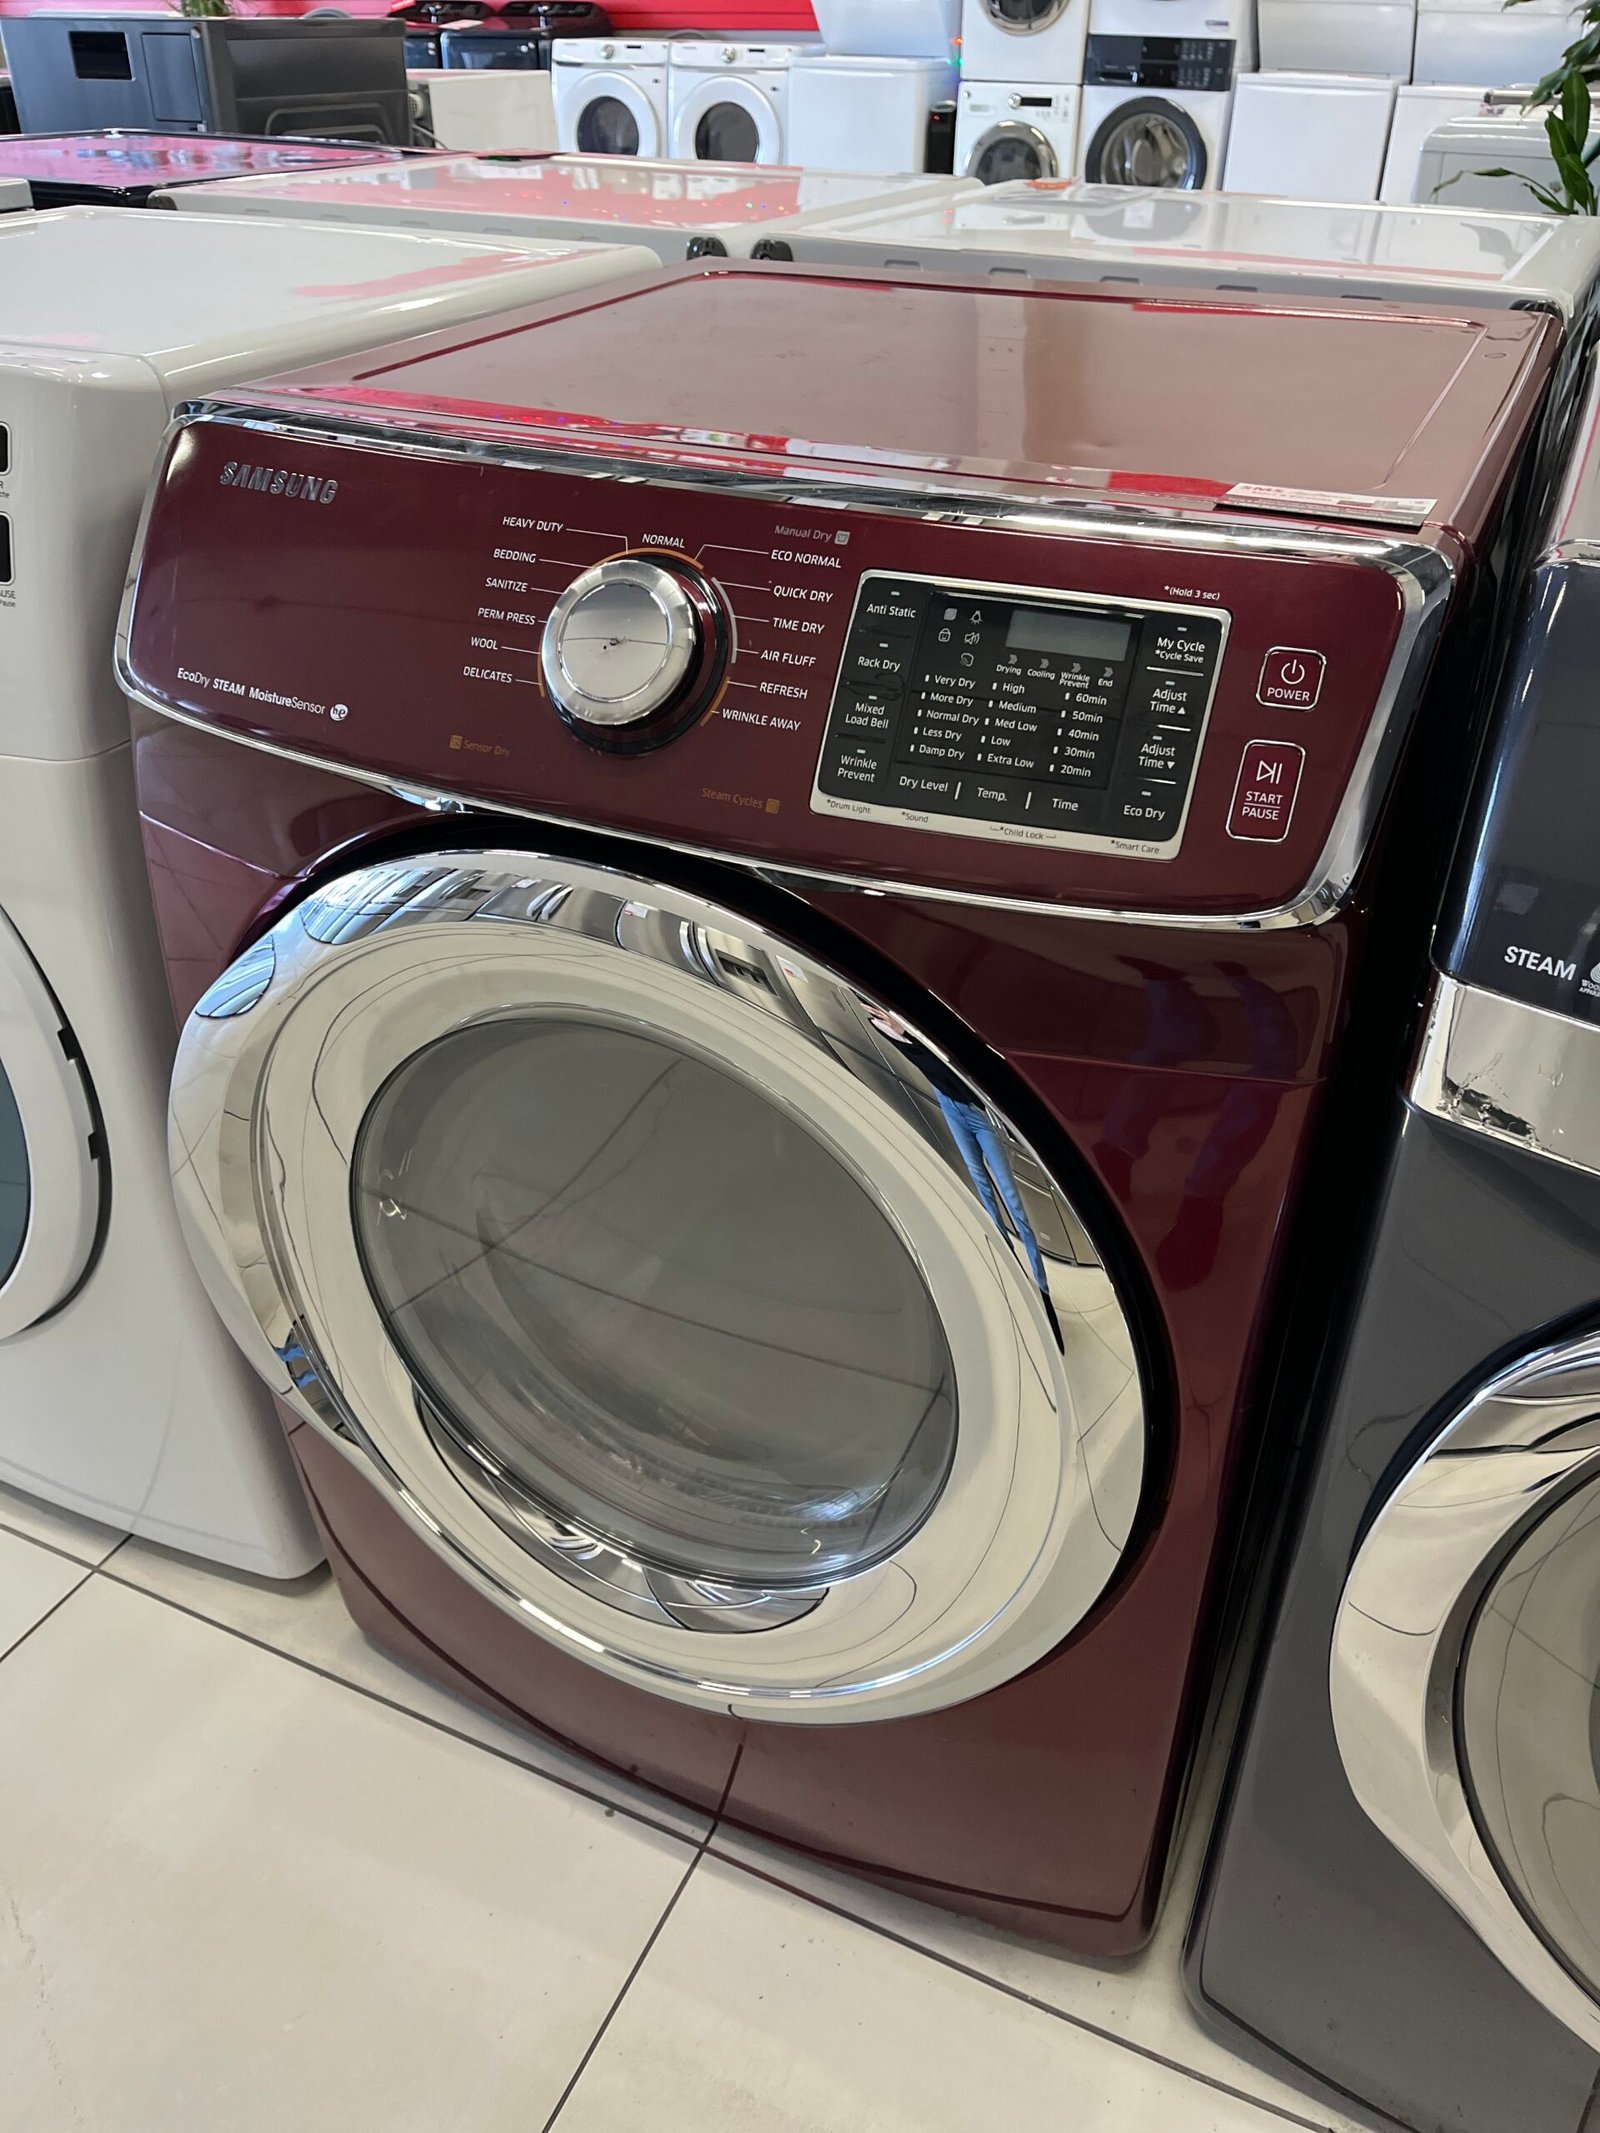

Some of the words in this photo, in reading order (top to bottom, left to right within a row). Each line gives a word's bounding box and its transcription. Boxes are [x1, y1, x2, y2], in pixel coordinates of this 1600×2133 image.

[220, 461, 338, 504] SAMSUNG
[502, 516, 535, 529] HEAVY
[536, 520, 563, 533] DUTY
[642, 533, 685, 549] NORMAL
[774, 525, 811, 538] Manual
[813, 530, 832, 542] Dry
[493, 548, 536, 563] BEDDING
[771, 550, 792, 562] ECO
[794, 553, 842, 568] NORMAL
[485, 577, 528, 592] SANITIZE
[773, 585, 807, 599] QUICK
[809, 590, 833, 602] DRY
[1194, 589, 1201, 598] 3
[1202, 591, 1220, 601] sec)
[477, 607, 504, 620] PERM
[506, 612, 536, 625] PRESS
[866, 603, 886, 615] Anti
[888, 606, 917, 618] Static
[772, 617, 799, 631] TIME
[801, 622, 825, 635] DRY
[471, 637, 498, 650] WOOL
[1156, 637, 1173, 650] My
[1177, 639, 1205, 654] Cycle
[760, 650, 779, 662] AIR
[782, 653, 816, 667] FLUFF
[857, 656, 880, 668] Rack
[882, 660, 900, 673] Dry
[1184, 653, 1204, 664] Save
[463, 666, 513, 683] DELICATES
[996, 664, 1021, 675] Drying
[1027, 668, 1056, 680] Cooling
[1060, 671, 1090, 682] Wrinkle
[934, 674, 956, 687] Very
[958, 678, 976, 690] Dry
[1002, 683, 1025, 694] High
[1059, 679, 1089, 689] Prevent
[1098, 678, 1113, 687] End
[177, 667, 210, 688] EcoDry
[212, 678, 246, 696] STEAM
[248, 686, 325, 715] MoistureSensor
[759, 682, 808, 699] REFRESH
[1152, 688, 1188, 702] Adjust
[1266, 687, 1310, 701] POWER
[930, 692, 954, 703] More
[956, 695, 974, 707] Dry
[998, 700, 1037, 714] Medium
[1075, 693, 1107, 706] 60min
[855, 703, 885, 716] Mixed
[1150, 702, 1176, 713] Time
[722, 708, 768, 726] WRINKLE
[769, 716, 801, 731] AWAY
[845, 714, 869, 726] Load
[870, 717, 889, 729] Bell
[926, 709, 960, 722] Normal
[962, 714, 980, 727] Dry
[1072, 710, 1103, 723] 50min
[995, 718, 1015, 729] Med
[1017, 721, 1037, 732] Low
[922, 727, 943, 738] Less
[945, 730, 962, 742] Dry
[991, 736, 1011, 747] Low
[1068, 728, 1099, 741] 40min
[463, 740, 493, 752] Sensor
[919, 744, 946, 757] Damp
[948, 748, 965, 760] Dry
[1064, 746, 1095, 759] 30min
[1140, 743, 1176, 757] Adjust
[840, 755, 877, 770] Wrinkle
[987, 753, 1012, 765] Extra
[1014, 757, 1034, 768] Low
[1138, 756, 1164, 768] Time
[837, 767, 875, 783] Prevent
[1060, 764, 1091, 777] 20min
[899, 776, 918, 790] Dry
[920, 779, 949, 792] Level
[701, 787, 731, 801] Steam
[733, 794, 763, 809] Cycles
[977, 787, 1007, 802] Temp.
[1245, 790, 1283, 805] START
[852, 804, 871, 815] Light
[1052, 798, 1079, 811] Time
[1123, 805, 1143, 817] Eco
[1144, 808, 1165, 821] Dry
[1242, 807, 1280, 820] PAUSE
[1025, 831, 1043, 840] Lock
[1141, 845, 1160, 854] Care
[1504, 945, 1577, 981] STEAM
